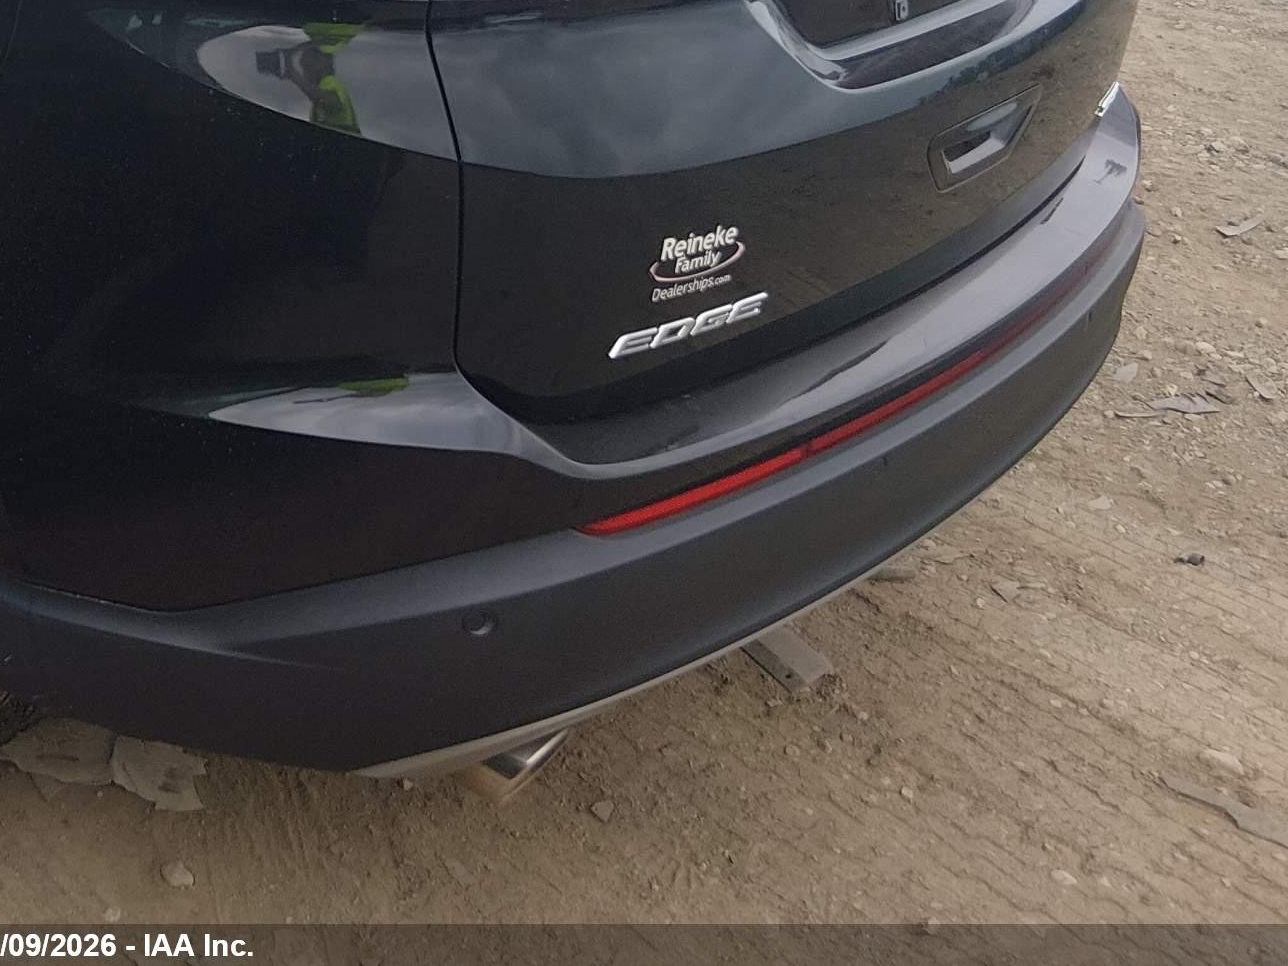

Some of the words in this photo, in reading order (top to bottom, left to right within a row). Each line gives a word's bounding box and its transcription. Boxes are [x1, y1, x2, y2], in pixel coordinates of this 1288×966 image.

[660, 225, 739, 262] Reineke
[674, 250, 722, 273] Family
[650, 274, 732, 303] Dealerships.com
[608, 292, 769, 359] EDGE
